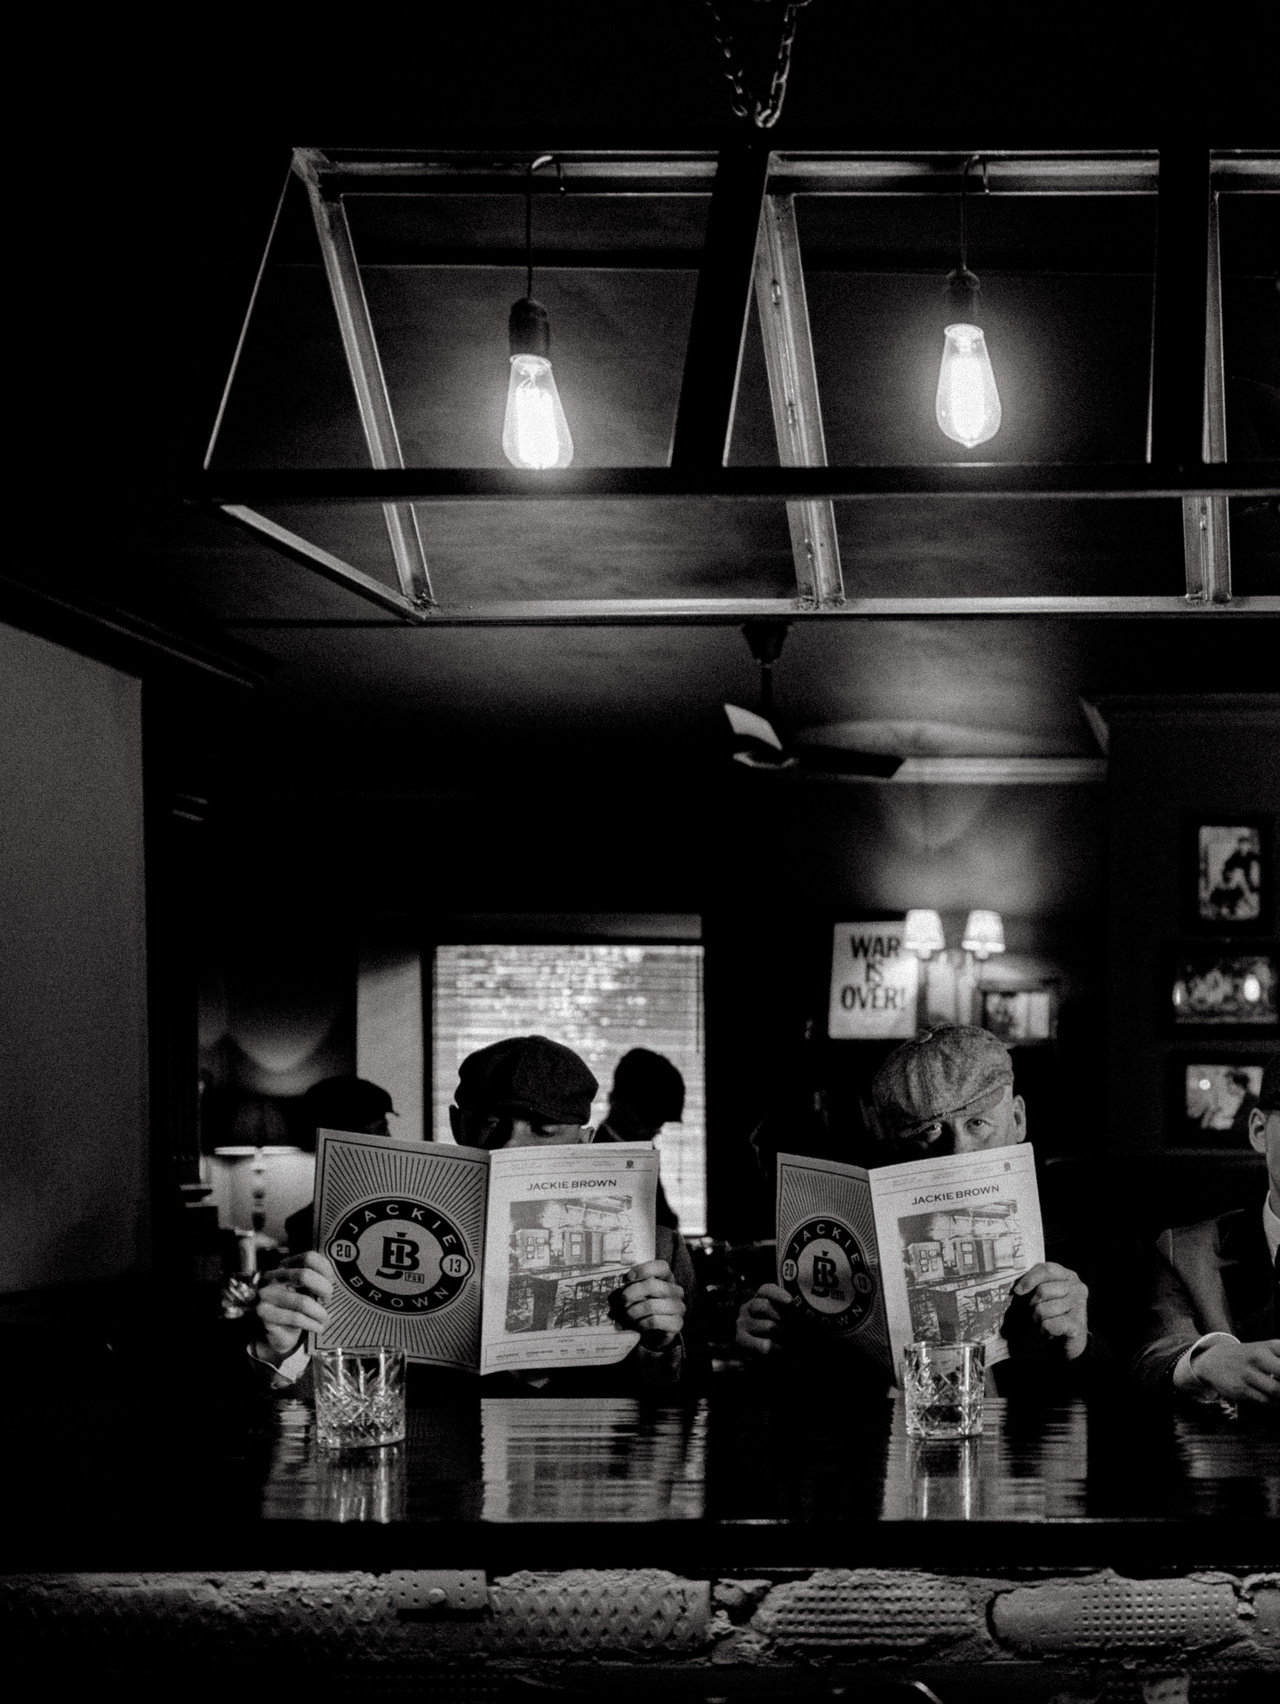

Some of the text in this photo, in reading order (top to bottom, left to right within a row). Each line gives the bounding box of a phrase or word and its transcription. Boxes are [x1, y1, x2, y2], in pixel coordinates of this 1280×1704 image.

[851, 934, 900, 958] WAR
[866, 959, 883, 986] IS
[841, 984, 907, 1011] OVER!
[527, 1179, 617, 1191] JACKIE BROWN
[912, 1185, 1000, 1206] JACKIE BROWN
[349, 1204, 457, 1247] JACKIE
[336, 1243, 351, 1259] 20
[793, 1223, 860, 1265] JACKIE
[449, 1257, 462, 1273] 13
[784, 1262, 795, 1278] 20
[349, 1275, 449, 1308] BROWN
